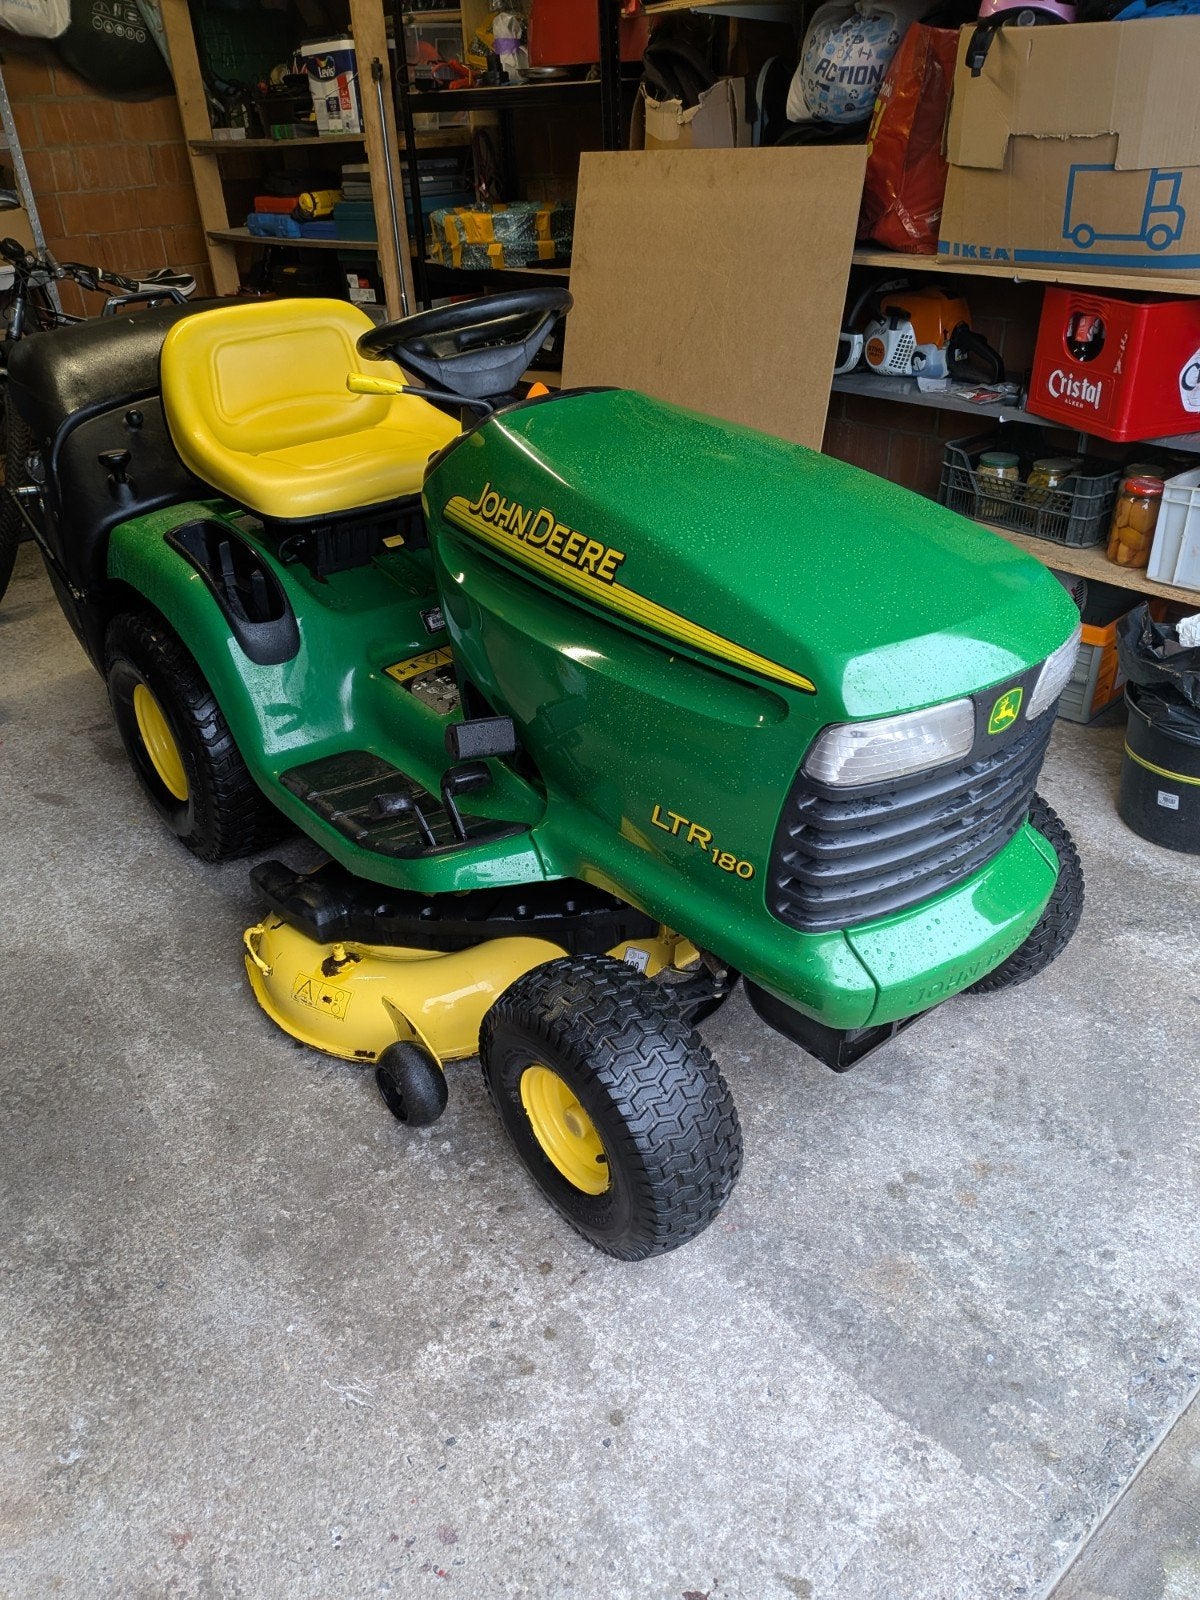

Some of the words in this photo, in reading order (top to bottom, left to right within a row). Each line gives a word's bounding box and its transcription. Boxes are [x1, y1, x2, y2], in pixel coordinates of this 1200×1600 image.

[814, 58, 884, 86] ACTION
[953, 242, 1010, 260] IKEA
[1048, 369, 1103, 410] Cristal
[468, 480, 534, 540] JOHN
[525, 507, 626, 586] DEERE
[651, 804, 713, 852] LTR
[711, 848, 756, 881] 180
